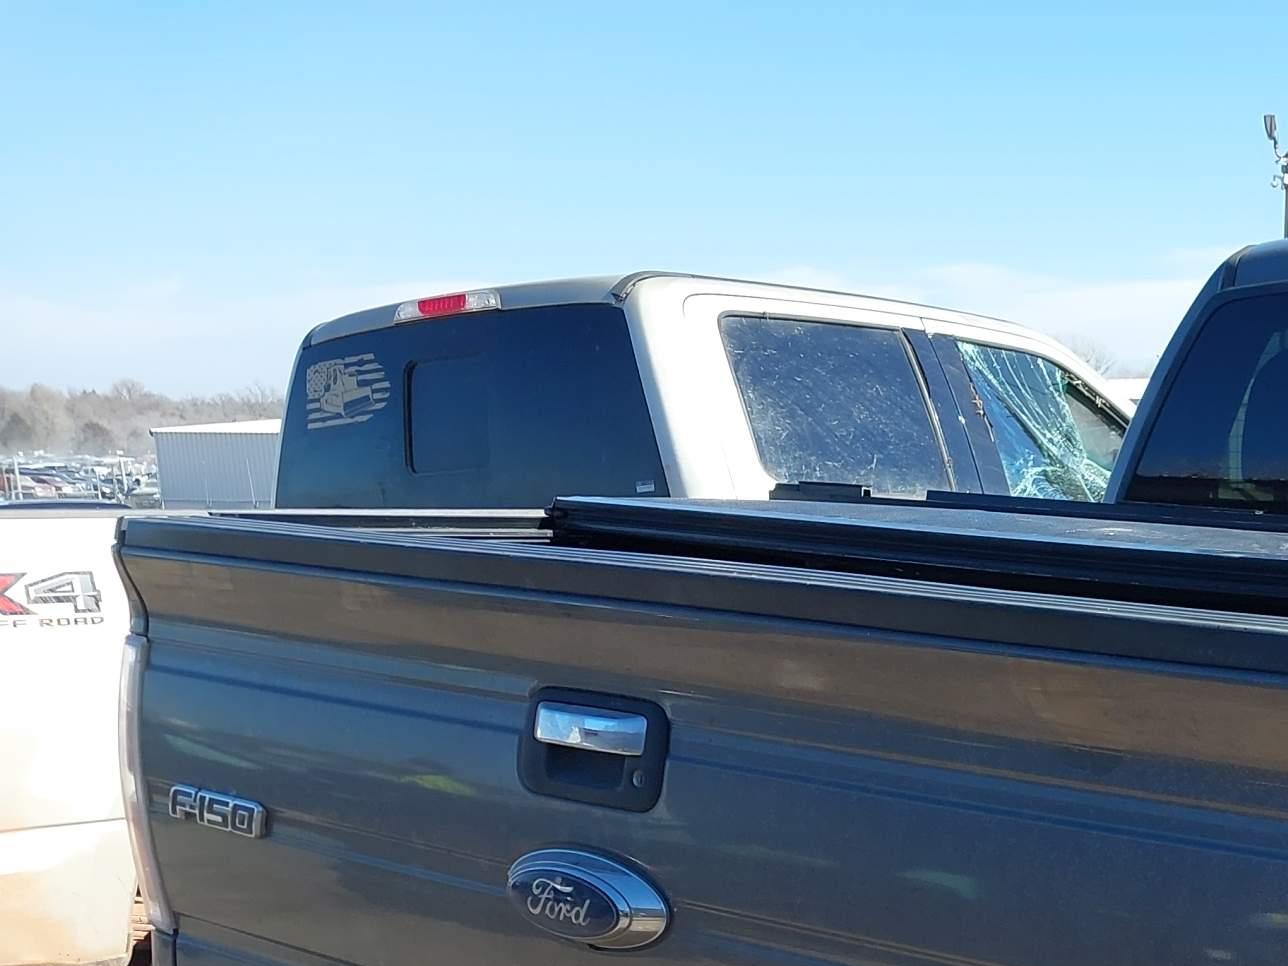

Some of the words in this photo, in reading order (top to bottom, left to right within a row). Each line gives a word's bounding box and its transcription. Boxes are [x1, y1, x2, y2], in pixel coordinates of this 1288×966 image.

[39, 616, 104, 628] ROAD
[169, 784, 265, 838] F-150
[527, 877, 591, 926] Ford
